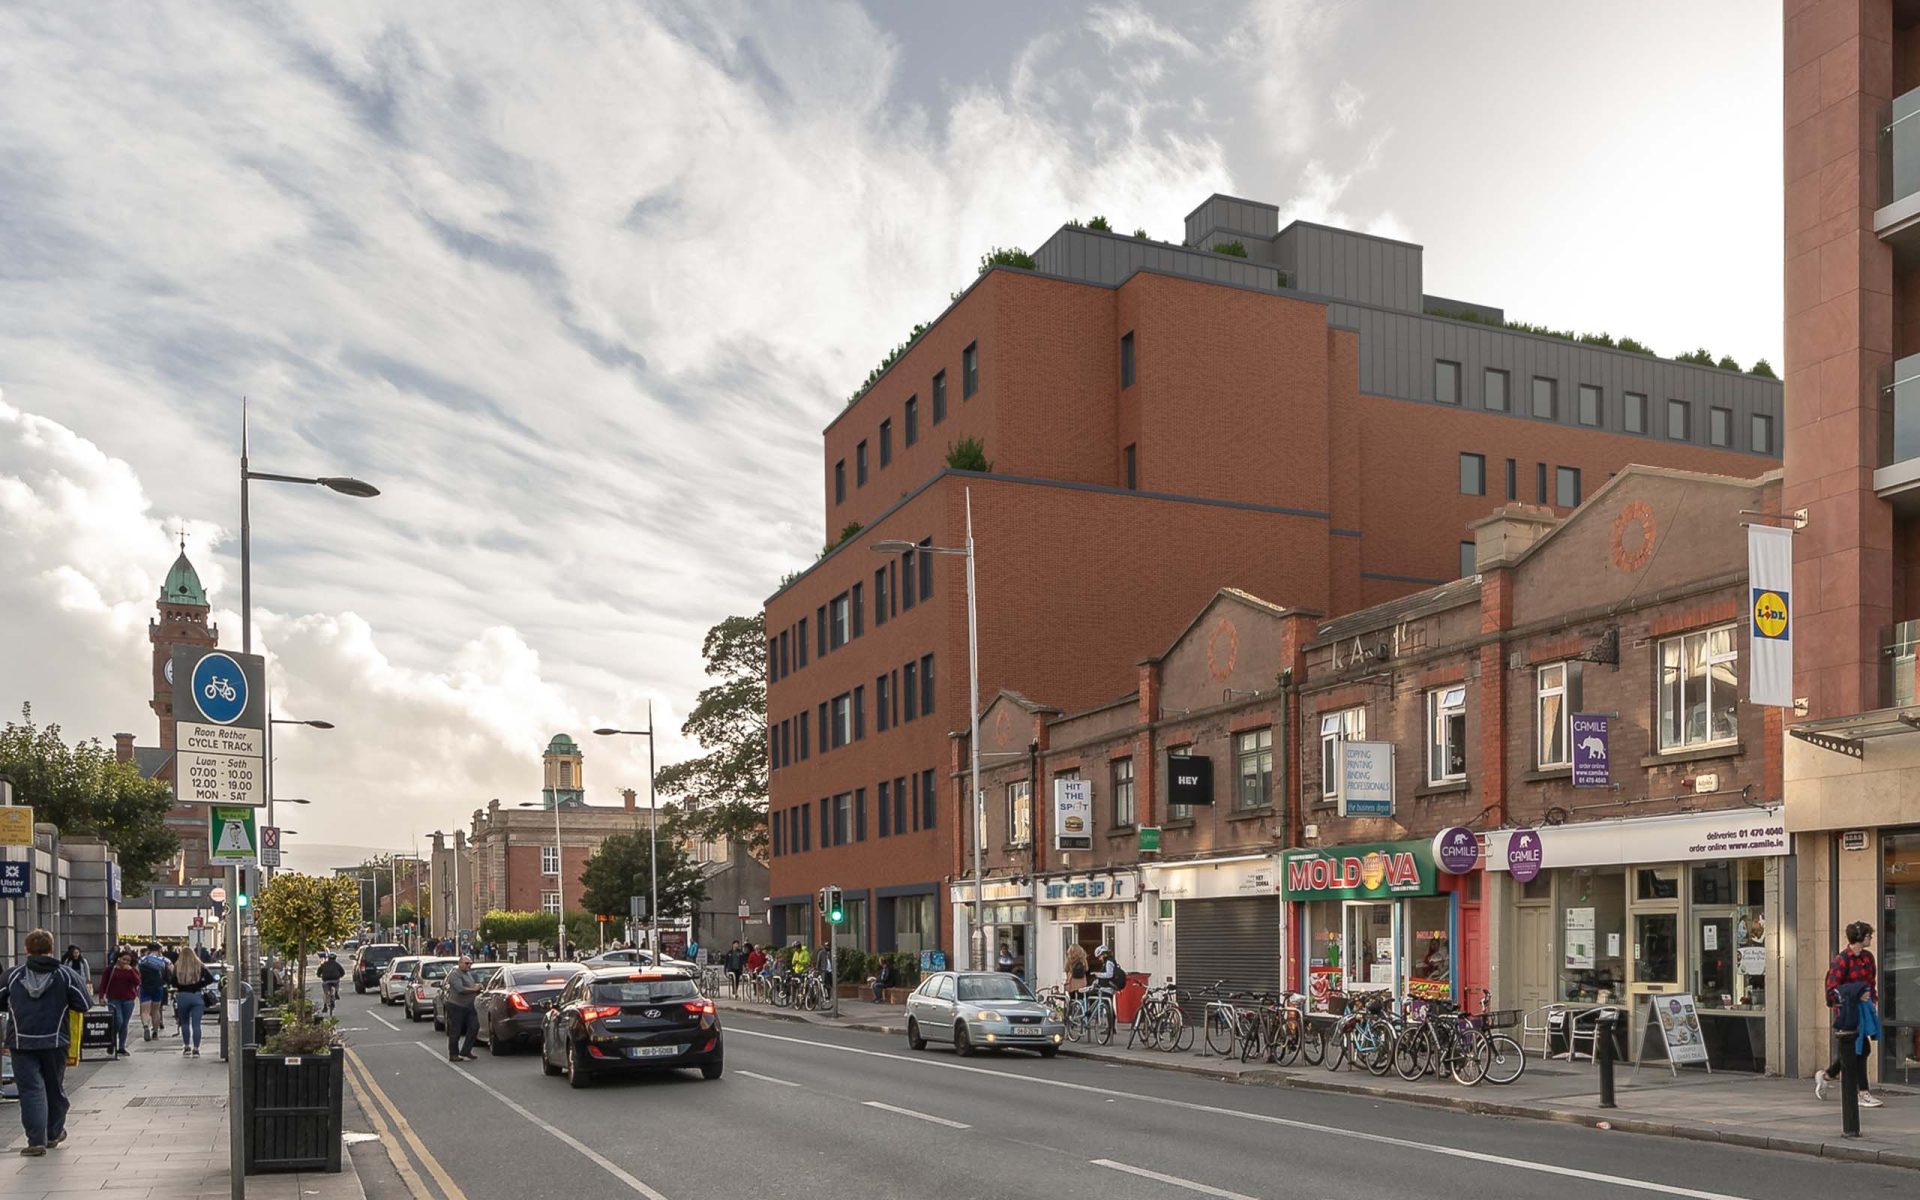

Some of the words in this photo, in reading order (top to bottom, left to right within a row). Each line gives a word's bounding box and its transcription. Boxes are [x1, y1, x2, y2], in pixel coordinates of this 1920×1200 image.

[1757, 605, 1785, 620] LIDL
[1574, 721, 1607, 732] CAMILE
[194, 727, 216, 737] Raon
[218, 729, 247, 740] Rothar
[188, 738, 218, 748] CYCLE
[222, 740, 253, 751] TRACK
[1347, 749, 1371, 758] COPYING
[196, 756, 217, 765] Luan
[227, 759, 247, 768] Sath
[1347, 760, 1373, 769] PRINTING
[190, 767, 217, 777] 07.00
[228, 770, 253, 780] 10.00
[191, 778, 217, 788] 12.00
[228, 781, 252, 790] 19.00
[1178, 776, 1198, 785] HEY
[1347, 781, 1390, 791] PROFESSIONALS
[196, 790, 218, 799] MON
[230, 791, 247, 801] SAT
[1065, 792, 1084, 800] THE
[1707, 831, 1737, 840] deliveries
[1739, 829, 1748, 838] 01
[1750, 828, 1764, 837] 470
[1765, 827, 1784, 836] 4040
[1441, 846, 1477, 857] CAMILE
[1689, 844, 1706, 853] order
[1707, 843, 1727, 851] online
[1728, 839, 1784, 850] www.camile.ie
[1509, 849, 1540, 862] CAMILE
[0, 879, 24, 887] Ulster
